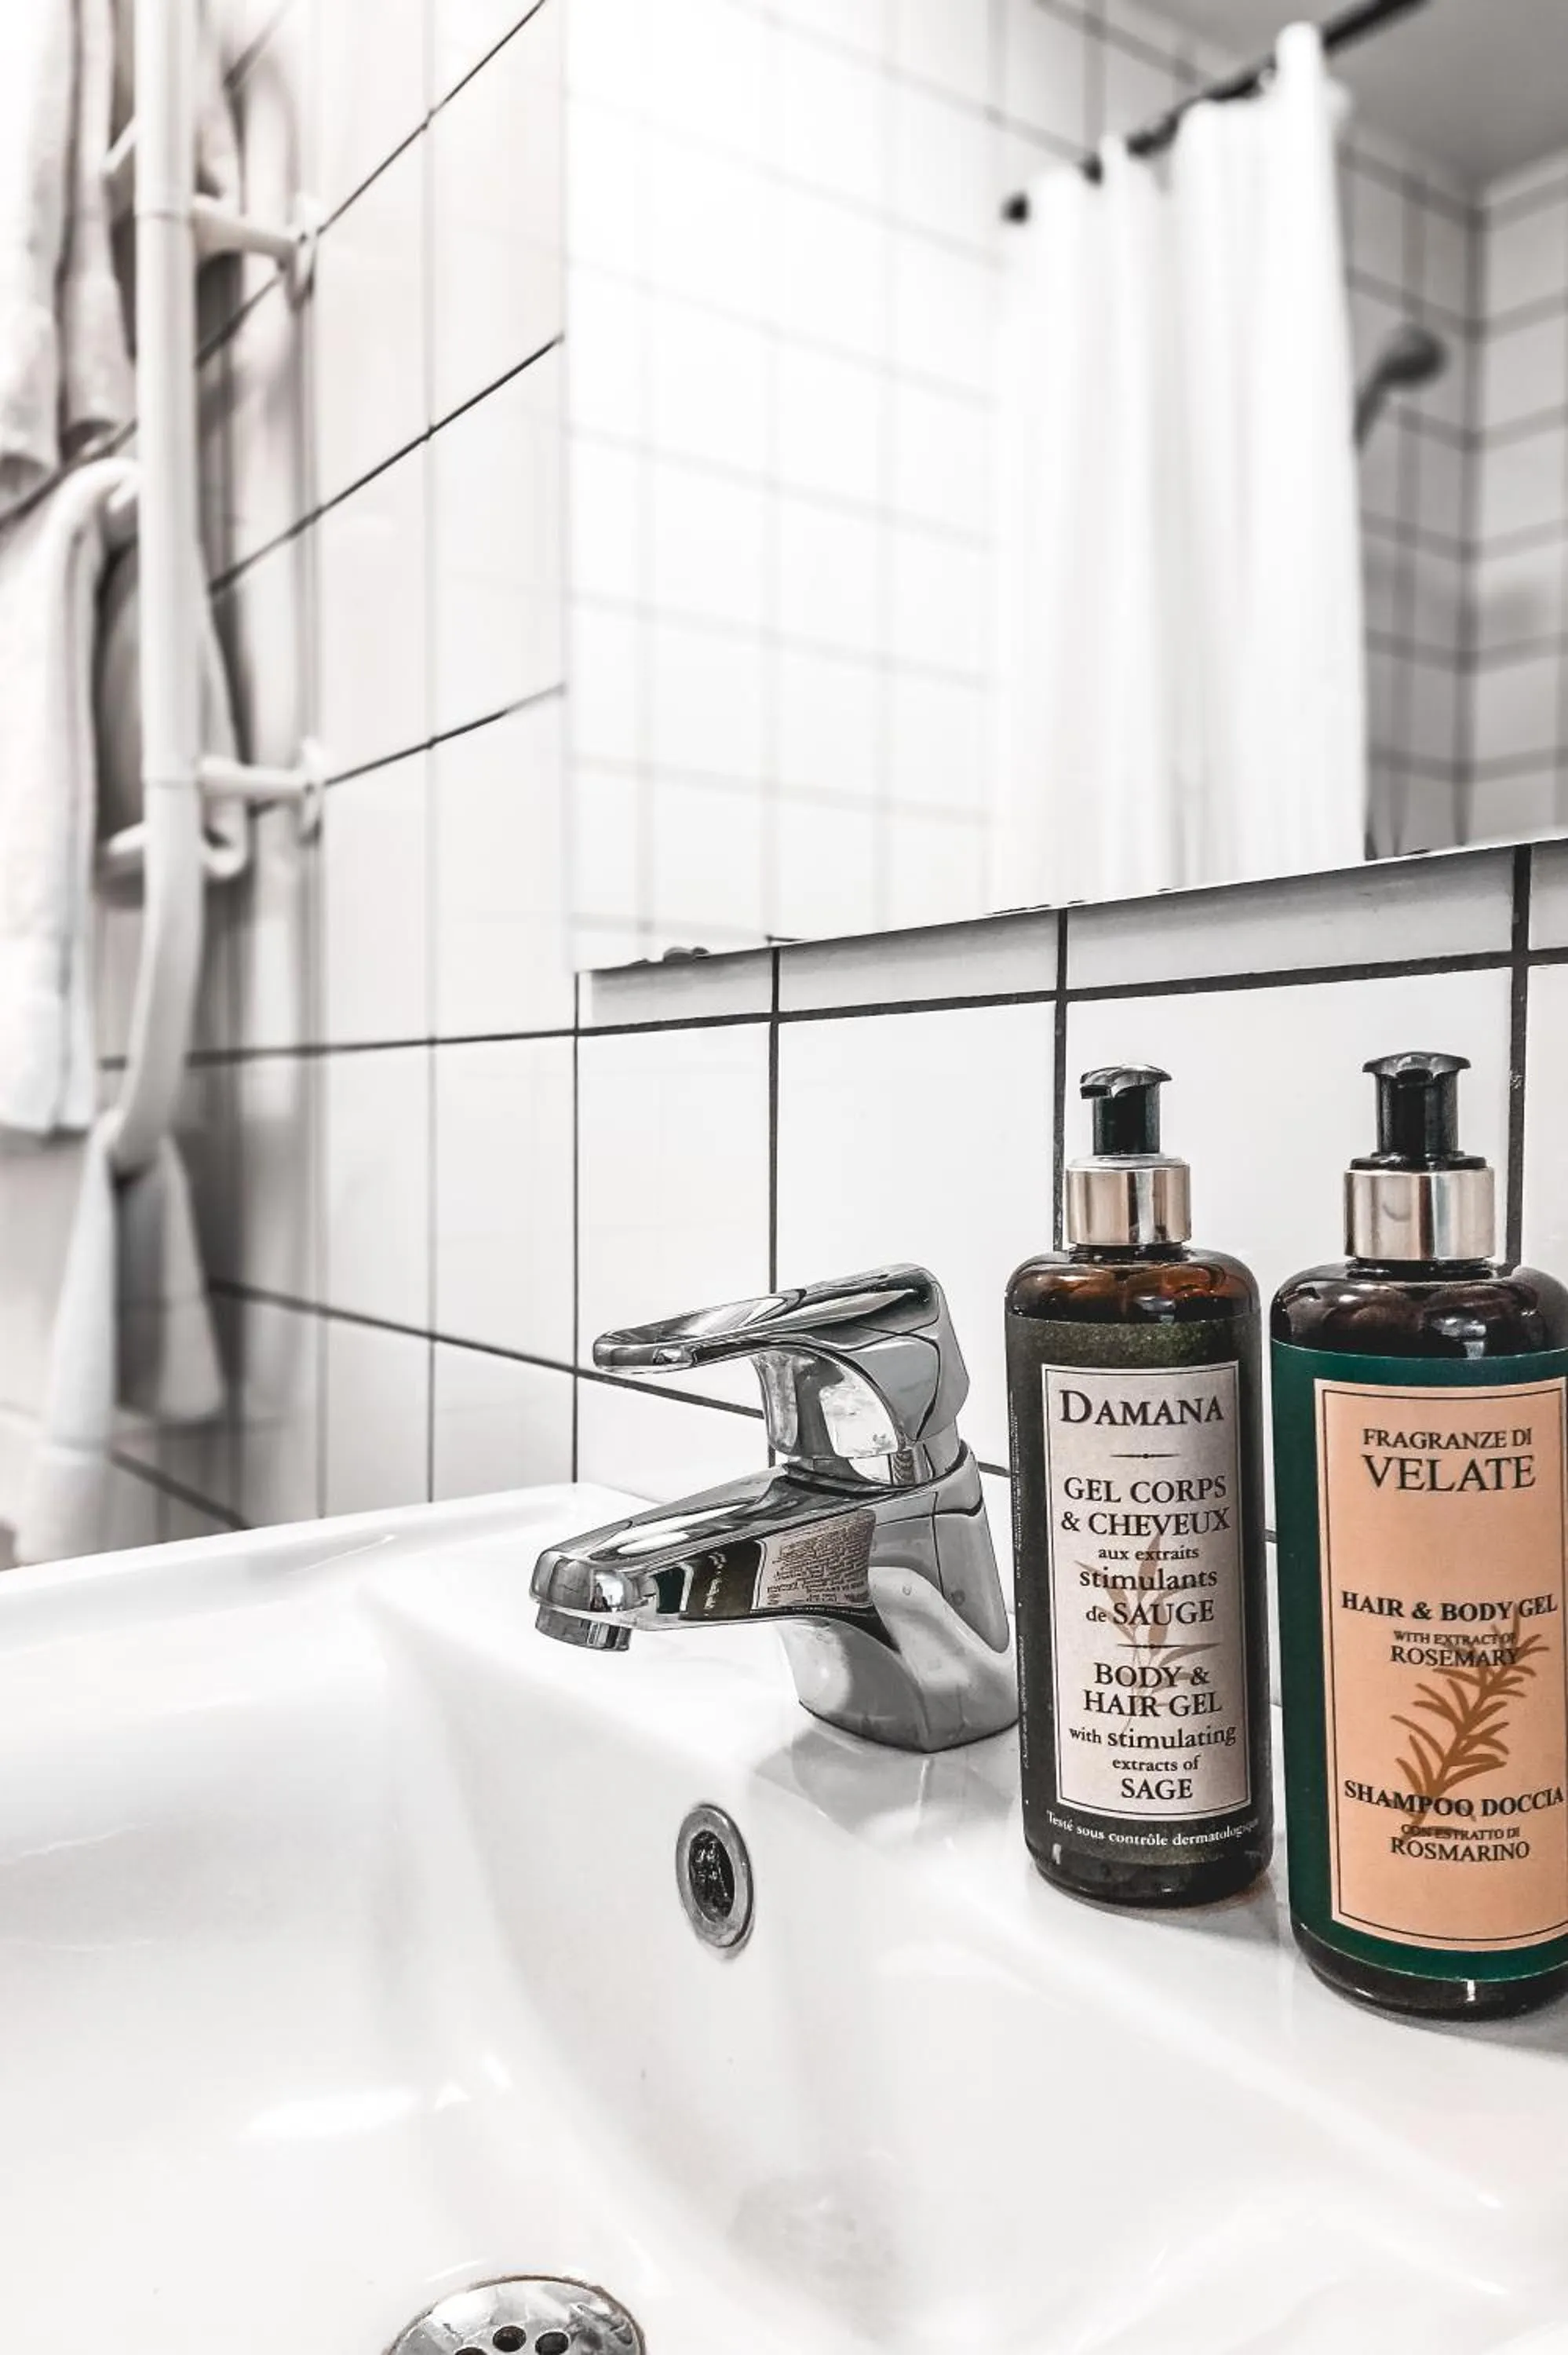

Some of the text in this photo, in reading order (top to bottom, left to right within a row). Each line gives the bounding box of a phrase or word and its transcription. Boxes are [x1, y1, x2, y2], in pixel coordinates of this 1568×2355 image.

[1362, 1426, 1533, 1450] FRAGRANZE DI
[1361, 1453, 1536, 1492] VELATE
[1063, 1475, 1227, 1503] GEL CORPS
[1061, 1507, 1231, 1536] & CHEVEUX
[1098, 1544, 1199, 1561] aux extraits
[1079, 1567, 1218, 1591] stimulants
[1085, 1600, 1215, 1627] de SAUGE
[1340, 1590, 1558, 1623] HAIR & BODY GEL
[1393, 1630, 1430, 1645] WITH
[1434, 1633, 1499, 1646] EXTRACT
[1391, 1645, 1518, 1667] ROSEMARY
[1094, 1662, 1212, 1689] BODY &
[1084, 1689, 1222, 1718] HAIR GEL
[1069, 1725, 1237, 1750] with stimulating
[1112, 1755, 1202, 1772] extracts of
[1121, 1778, 1194, 1800] SAGE
[1344, 1780, 1565, 1817] SHAMPOO DOCCIA
[1046, 1809, 1074, 1831] Testé
[1077, 1827, 1105, 1840] sous
[1109, 1831, 1168, 1846] contrôle
[1401, 1824, 1521, 1841] CON ESTRATTO DI
[1390, 1836, 1531, 1862] ROSMARINO
